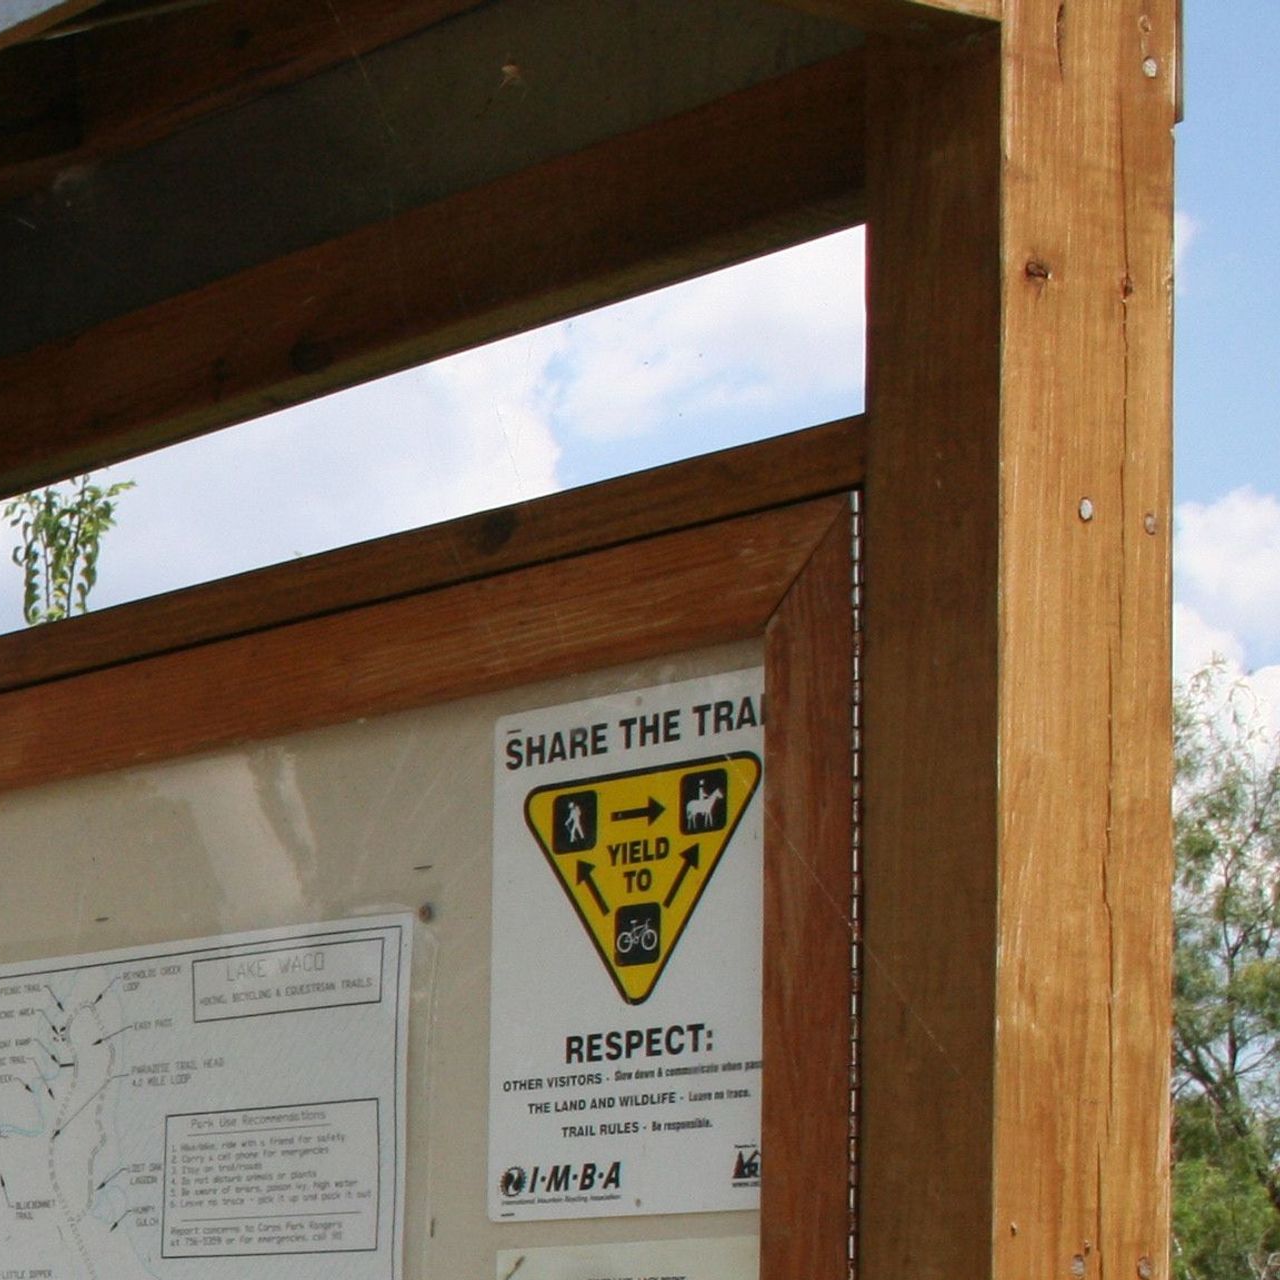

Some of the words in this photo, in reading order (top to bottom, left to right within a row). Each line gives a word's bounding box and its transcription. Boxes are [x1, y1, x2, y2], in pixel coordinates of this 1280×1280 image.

[505, 722, 608, 771] SHARE
[619, 709, 680, 750] THE
[692, 693, 765, 736] TRAI
[607, 837, 669, 866] YIELD
[624, 868, 652, 894] TO
[226, 959, 267, 982] LAKE
[279, 952, 324, 975] WACO
[341, 977, 372, 990] TRAILS
[565, 1022, 713, 1064] RESPECT:
[503, 1078, 544, 1092] OTHER
[546, 1072, 602, 1089] VISITORS
[614, 1070, 632, 1081] Slow
[634, 1069, 655, 1079] down
[656, 1067, 663, 1077] &
[665, 1063, 719, 1077] communicate
[722, 1061, 742, 1072] when
[527, 1102, 550, 1115] THE
[554, 1098, 586, 1113] LAND
[589, 1095, 615, 1109] AND
[619, 1091, 676, 1108] WILDLIFE
[689, 1090, 712, 1102] Leave
[714, 1091, 724, 1099] no
[561, 1125, 596, 1139] TRAIL
[599, 1121, 640, 1136] RULES
[651, 1121, 661, 1132] Be
[663, 1117, 713, 1132] responsible.
